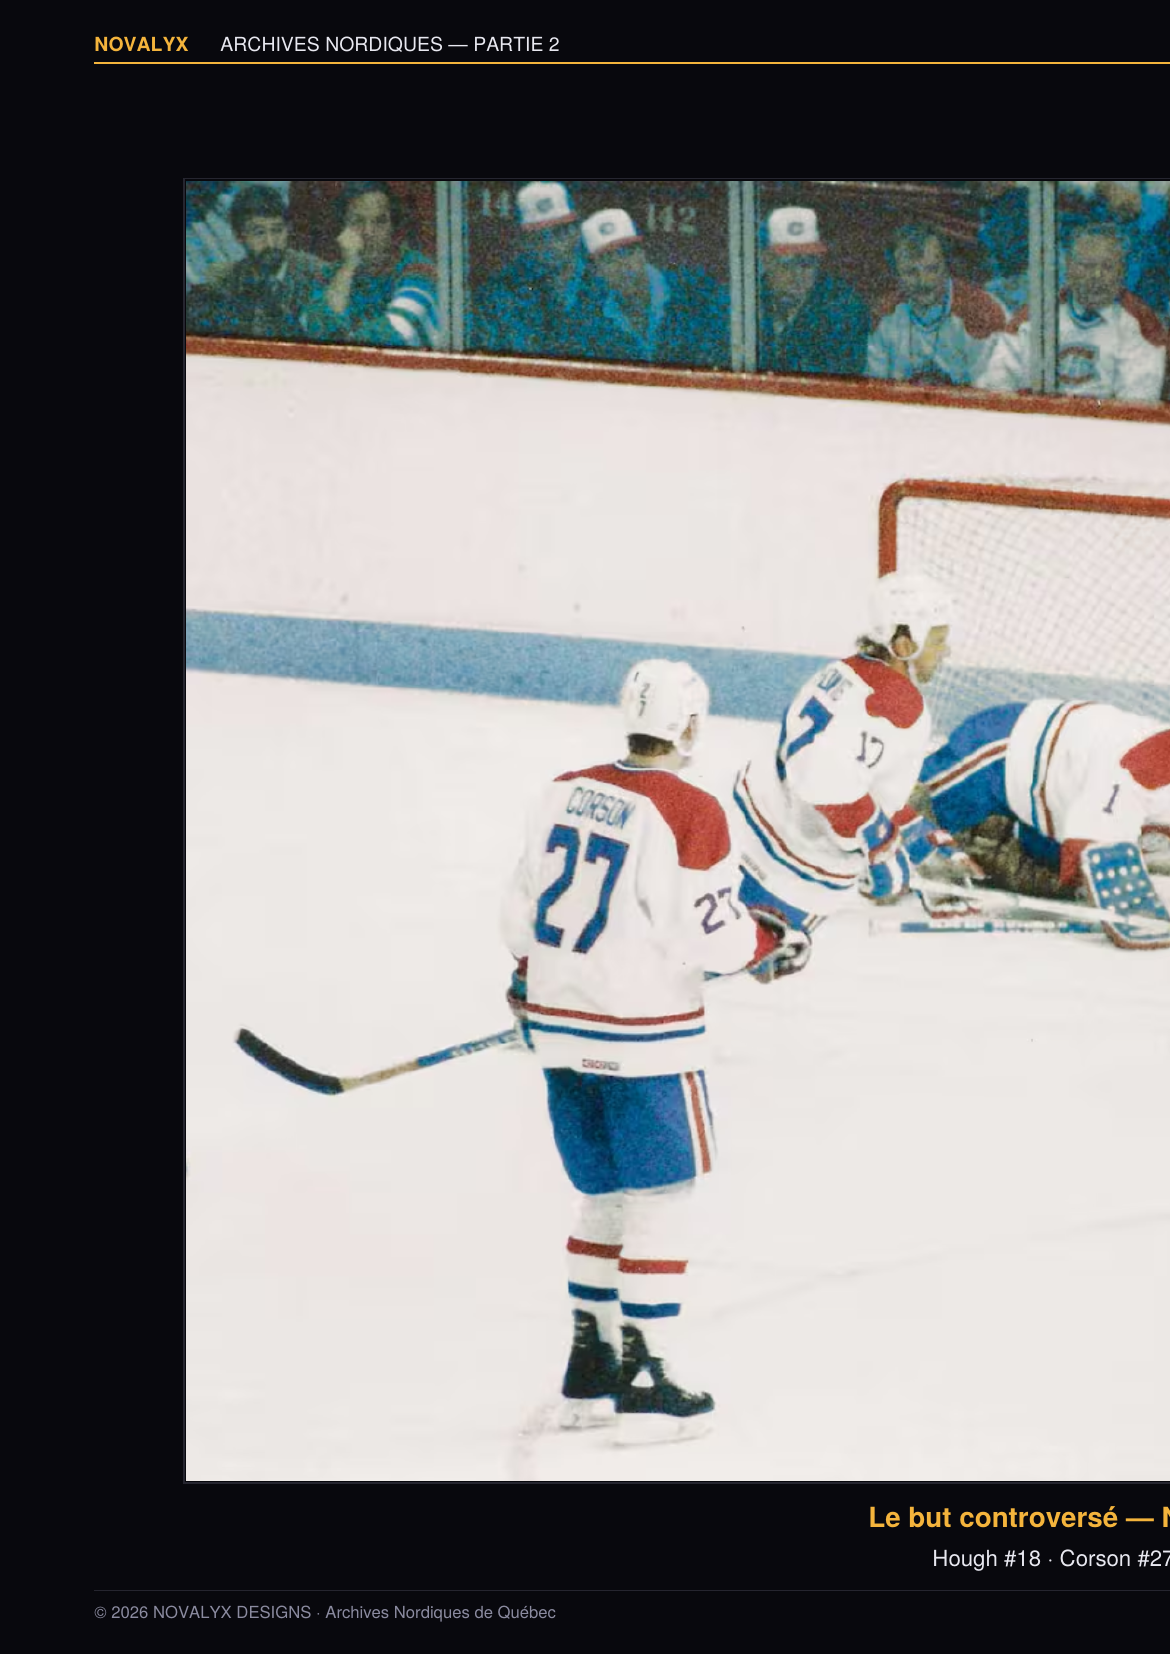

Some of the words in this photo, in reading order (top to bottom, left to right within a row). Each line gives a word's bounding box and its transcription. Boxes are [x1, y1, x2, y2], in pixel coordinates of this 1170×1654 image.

[647, 203, 698, 235] 142
[856, 730, 885, 770] 17
[566, 786, 637, 830] CORSON
[1102, 784, 1121, 815] 1
[534, 823, 630, 954] 27
[694, 886, 742, 935] 27
